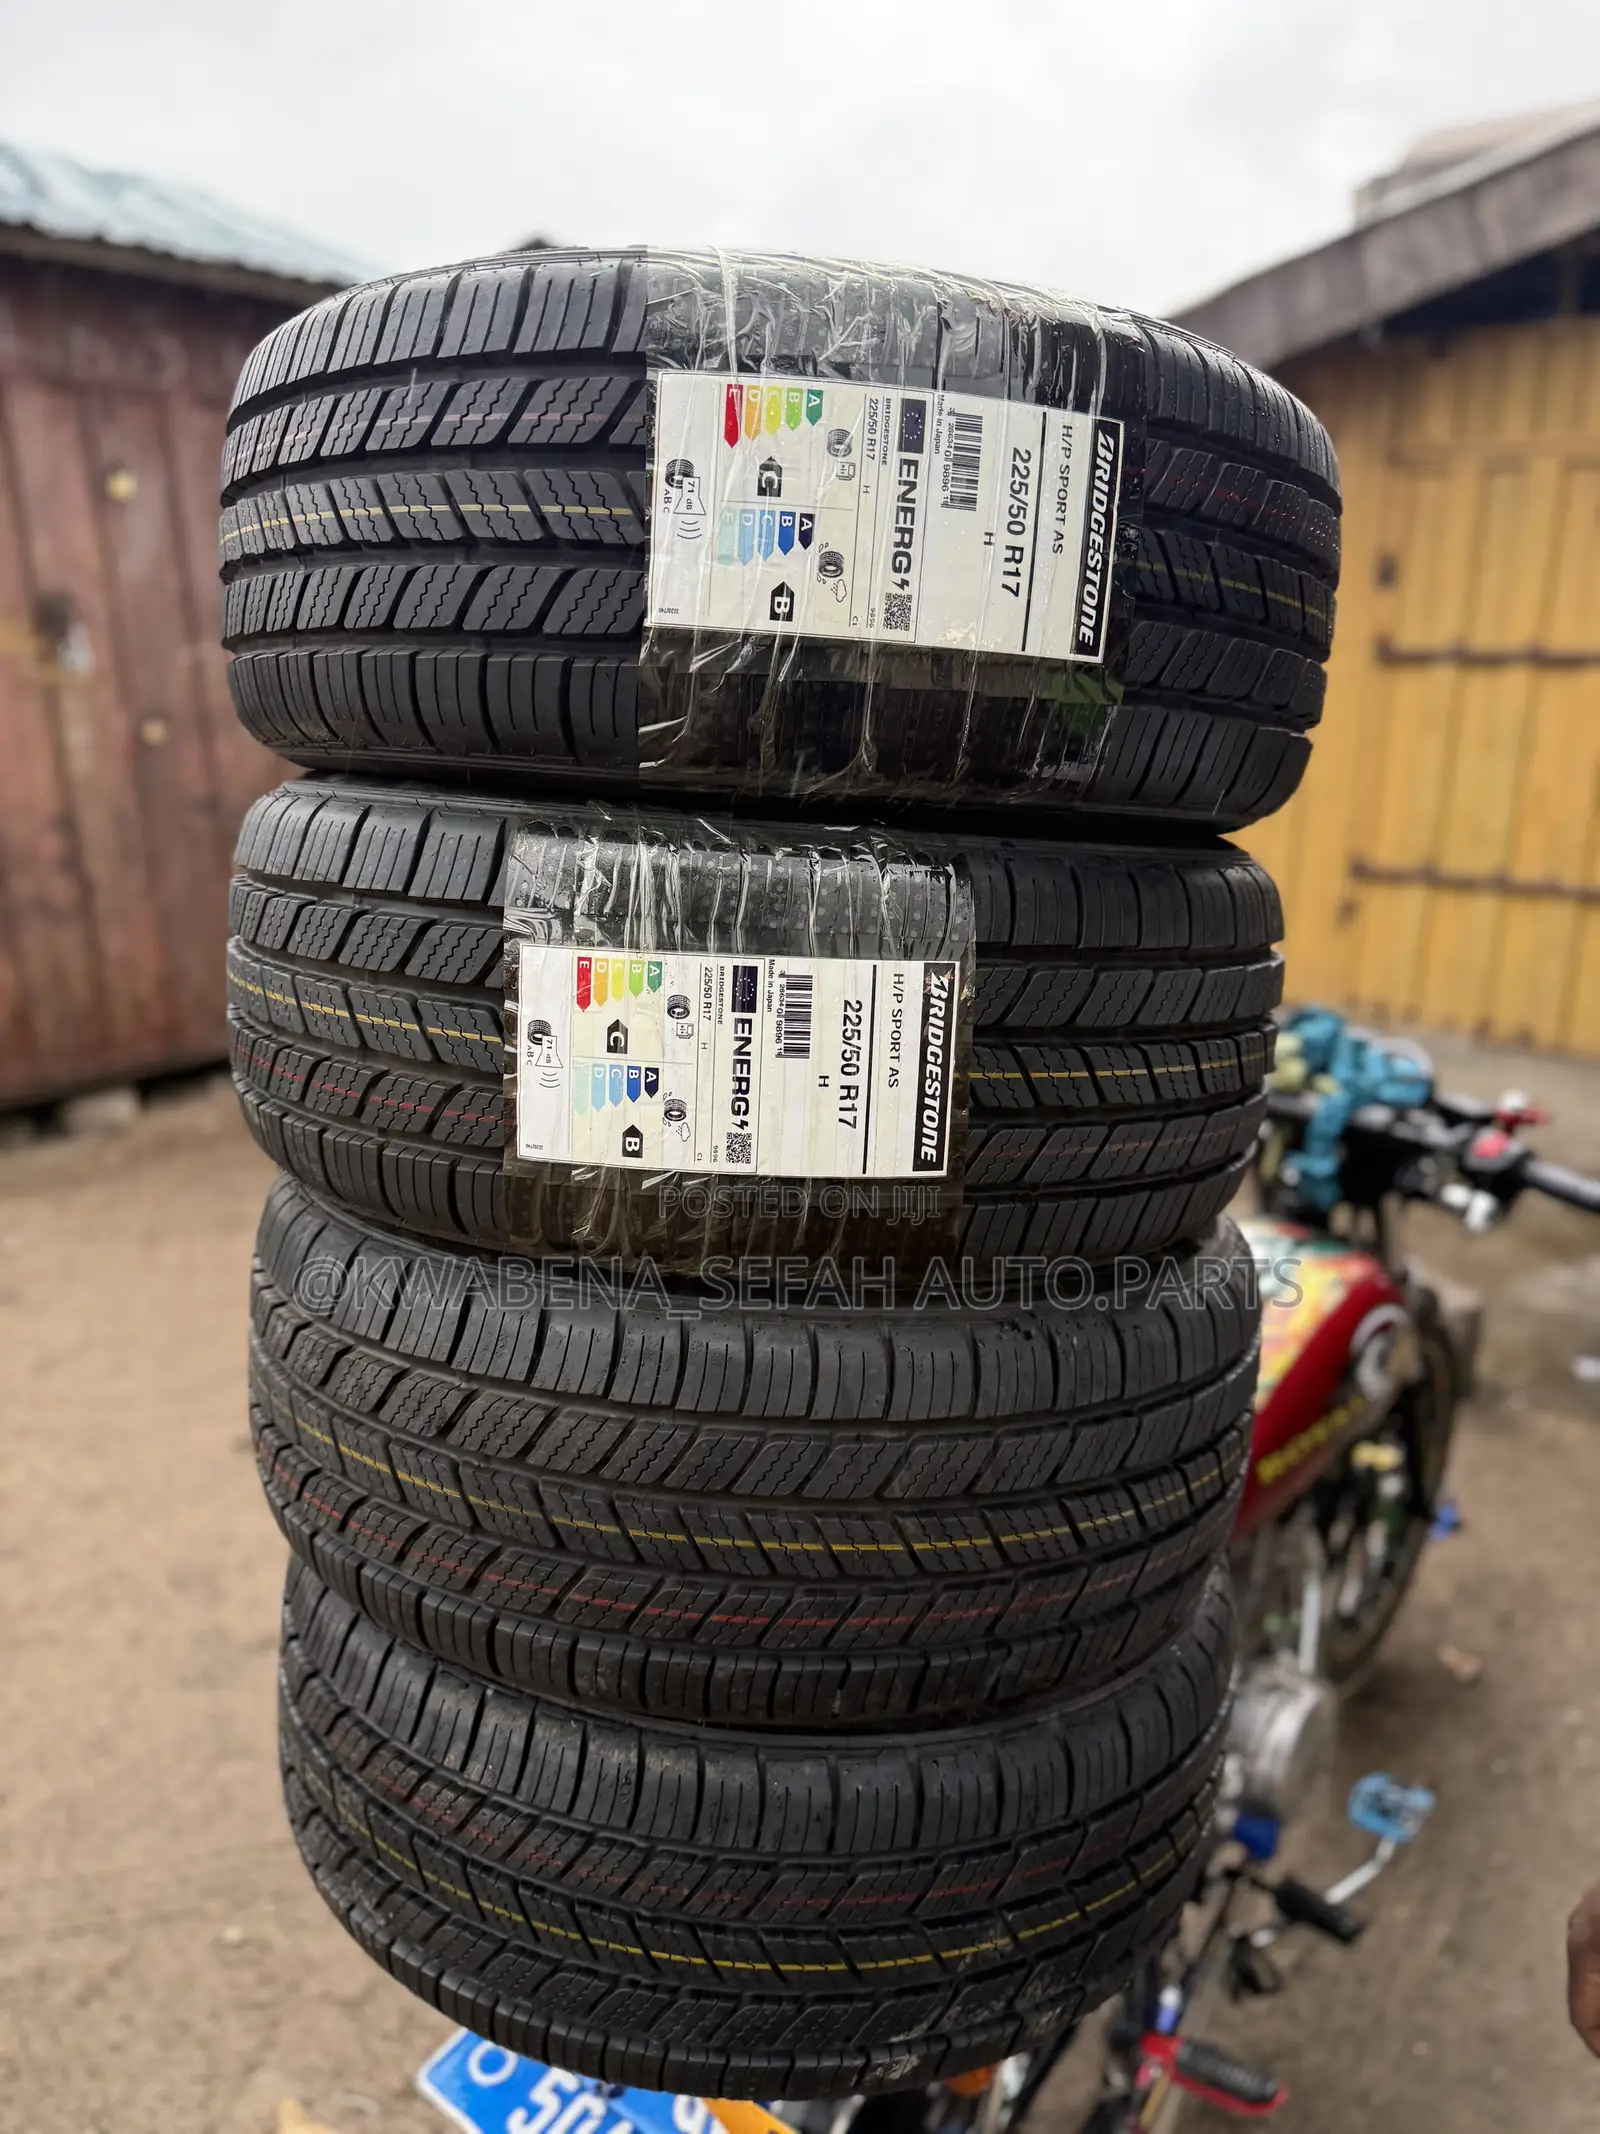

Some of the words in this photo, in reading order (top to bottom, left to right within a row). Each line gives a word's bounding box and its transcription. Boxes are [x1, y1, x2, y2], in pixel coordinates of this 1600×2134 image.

[749, 389, 760, 402] D
[789, 392, 800, 403] B
[808, 393, 820, 408] A
[937, 394, 945, 416] Made
[868, 398, 879, 435] 225/50
[937, 418, 943, 427] in
[882, 398, 892, 466] BRIDGESTONE
[934, 428, 943, 455] Japan
[1061, 425, 1073, 460] H/P
[866, 438, 877, 461] R17
[687, 481, 695, 493] 71
[762, 471, 779, 489] C
[862, 485, 870, 494] H
[1006, 447, 1032, 536] 225/50
[1055, 463, 1071, 527] SPORT
[686, 498, 693, 510] dB
[742, 513, 754, 526] D
[761, 514, 773, 526] C
[781, 515, 793, 527] B
[891, 458, 919, 574] ENERG
[801, 517, 813, 531] A
[983, 531, 995, 546] H
[1052, 530, 1065, 555] AS
[1079, 429, 1115, 648] BRIDGESTONE
[1001, 544, 1024, 599] R17
[774, 596, 790, 614] B
[579, 960, 590, 969] E
[597, 961, 607, 973] D
[631, 963, 641, 974] B
[649, 964, 660, 977] A
[704, 966, 713, 999] 225/50
[892, 973, 904, 1003] H/P
[717, 965, 725, 1025] BRIDGESTONE
[766, 989, 774, 1013] Japan
[702, 1001, 712, 1021] R17
[610, 1031, 625, 1047] C
[841, 999, 863, 1077] 225/50
[889, 1008, 903, 1063] SPORT
[546, 1039, 553, 1050] 71
[701, 1042, 708, 1050] H
[545, 1053, 552, 1064] dB
[593, 1067, 604, 1079] D
[611, 1068, 622, 1079] C
[628, 1069, 639, 1079] B
[731, 1017, 753, 1117] ENERG
[920, 972, 949, 1163] BRIDGESTONE
[646, 1070, 657, 1083] A
[817, 1075, 830, 1088] H
[888, 1066, 899, 1089] AS
[838, 1084, 860, 1130] R17
[625, 1137, 640, 1152] B
[697, 1152, 703, 1161] C1
